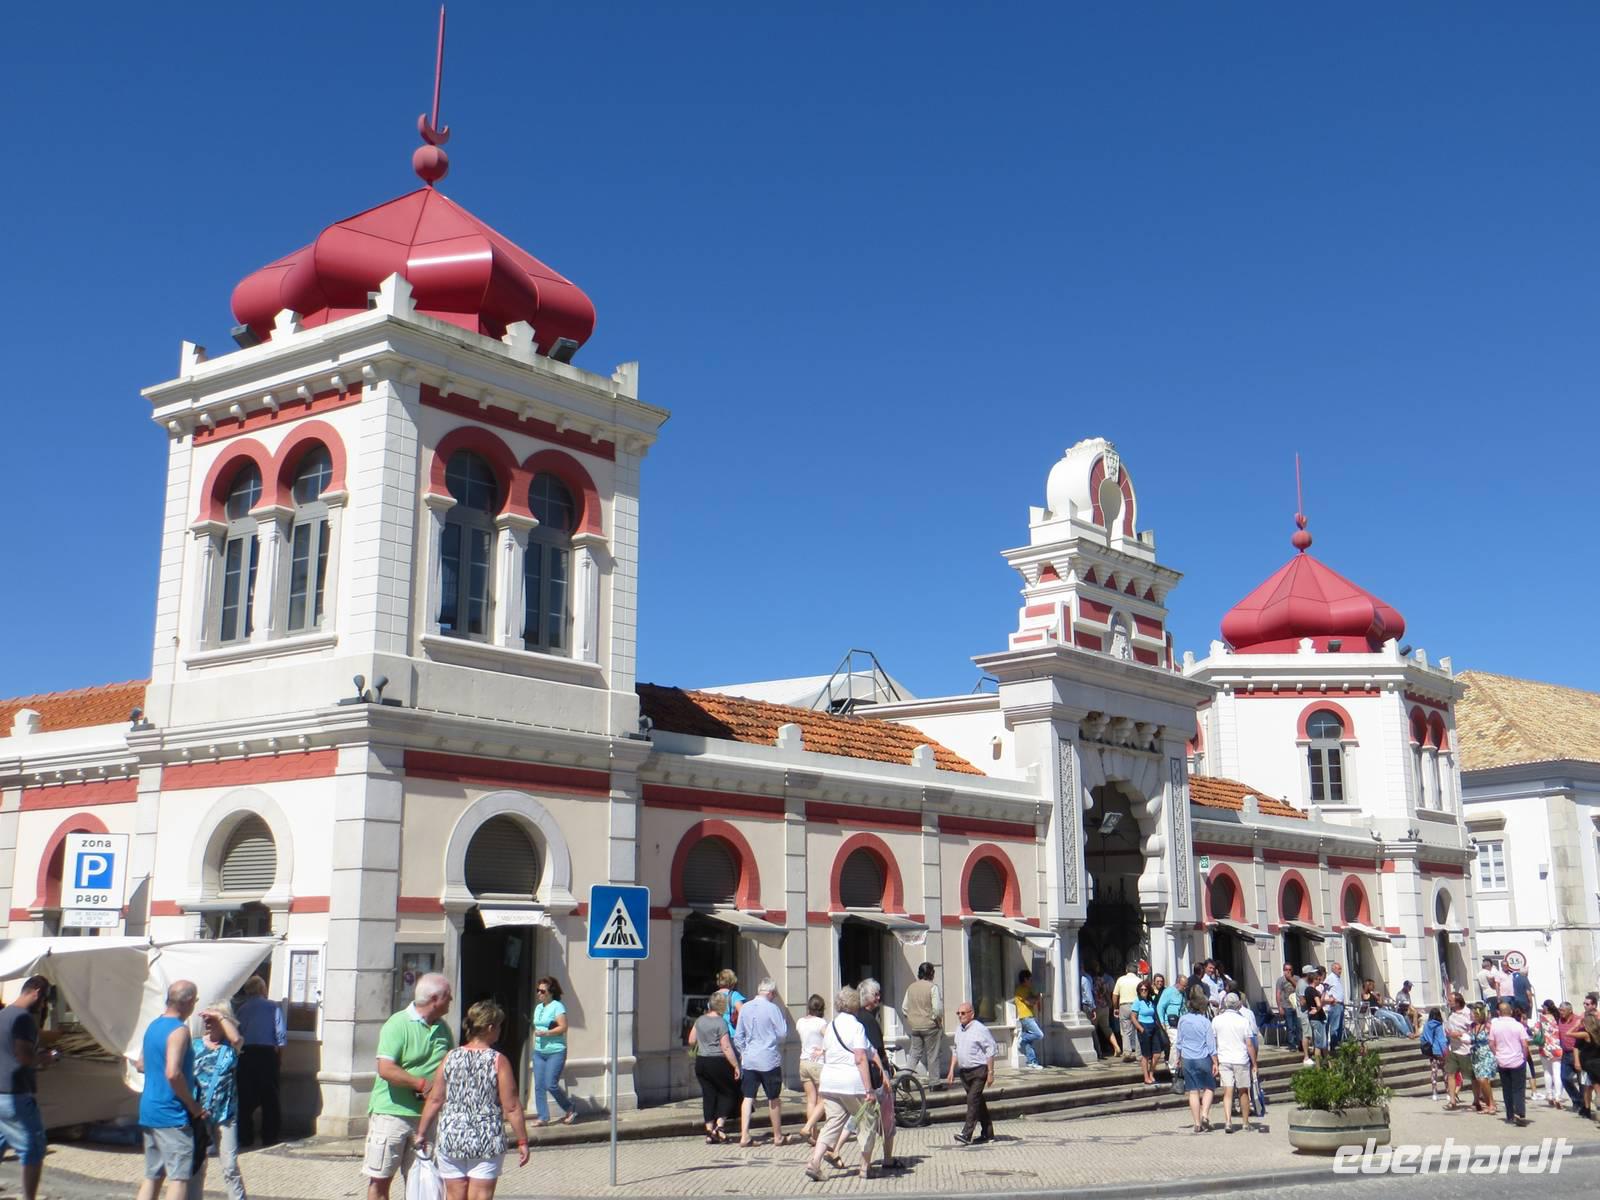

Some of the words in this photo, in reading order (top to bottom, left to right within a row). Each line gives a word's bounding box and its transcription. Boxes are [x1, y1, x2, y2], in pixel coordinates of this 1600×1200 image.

[81, 839, 112, 848] zona
[80, 855, 108, 887] P
[75, 894, 107, 904] pago
